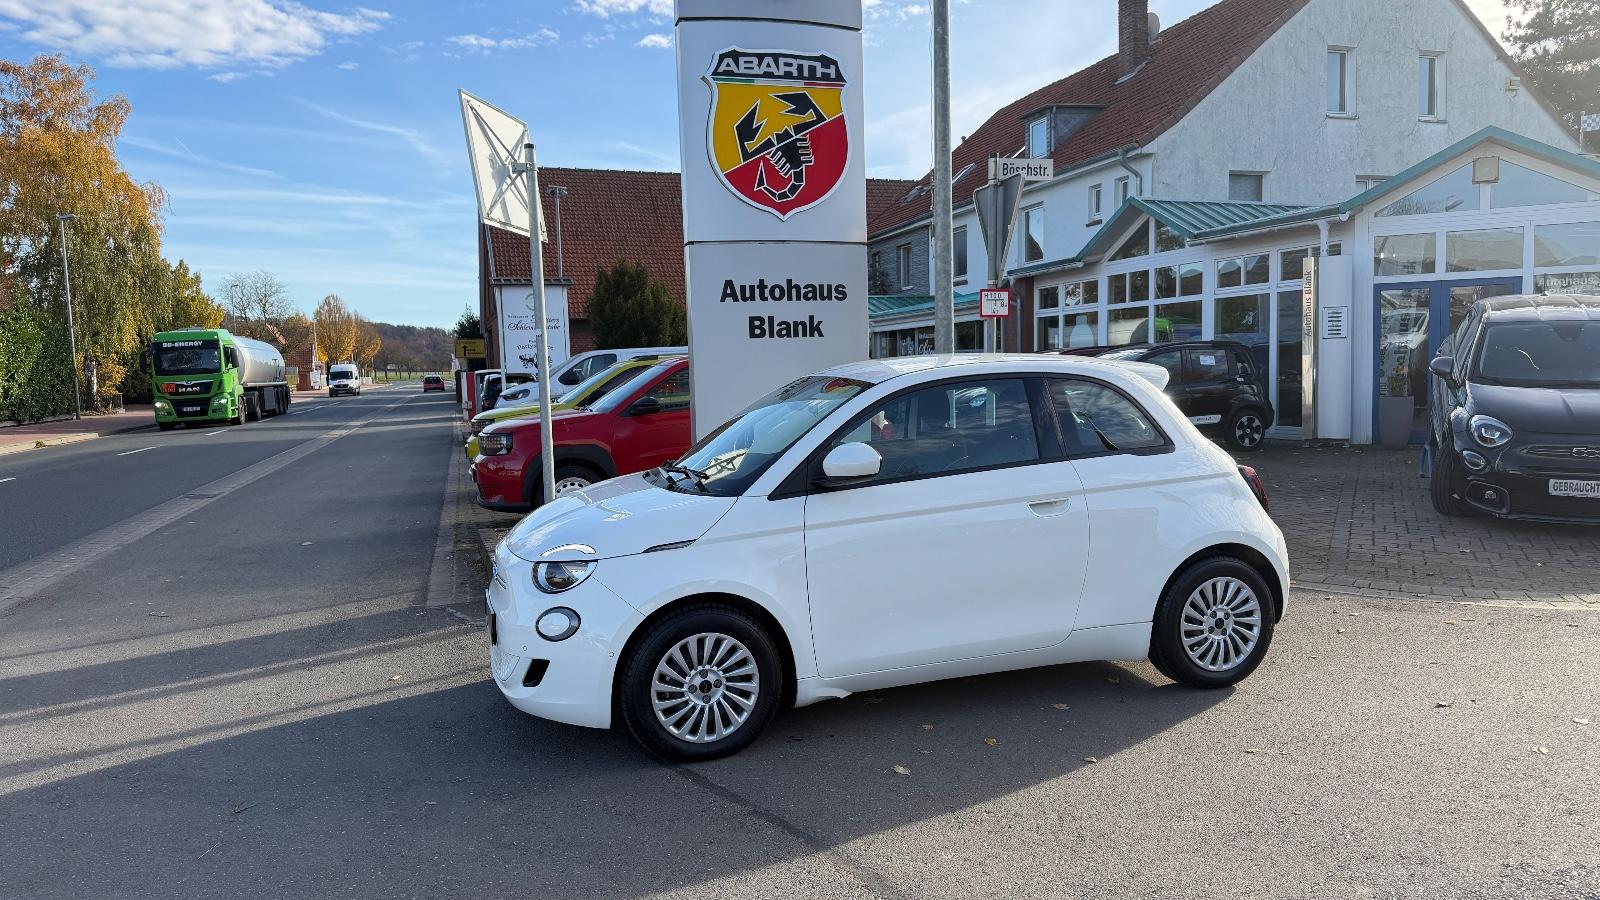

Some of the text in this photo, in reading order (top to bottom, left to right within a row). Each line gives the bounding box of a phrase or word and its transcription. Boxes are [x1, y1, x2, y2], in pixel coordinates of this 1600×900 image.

[716, 56, 836, 79] ABARTH
[719, 278, 848, 303] Autohaus
[1304, 270, 1312, 336] Autohaus Blank
[748, 314, 825, 339] Blank
